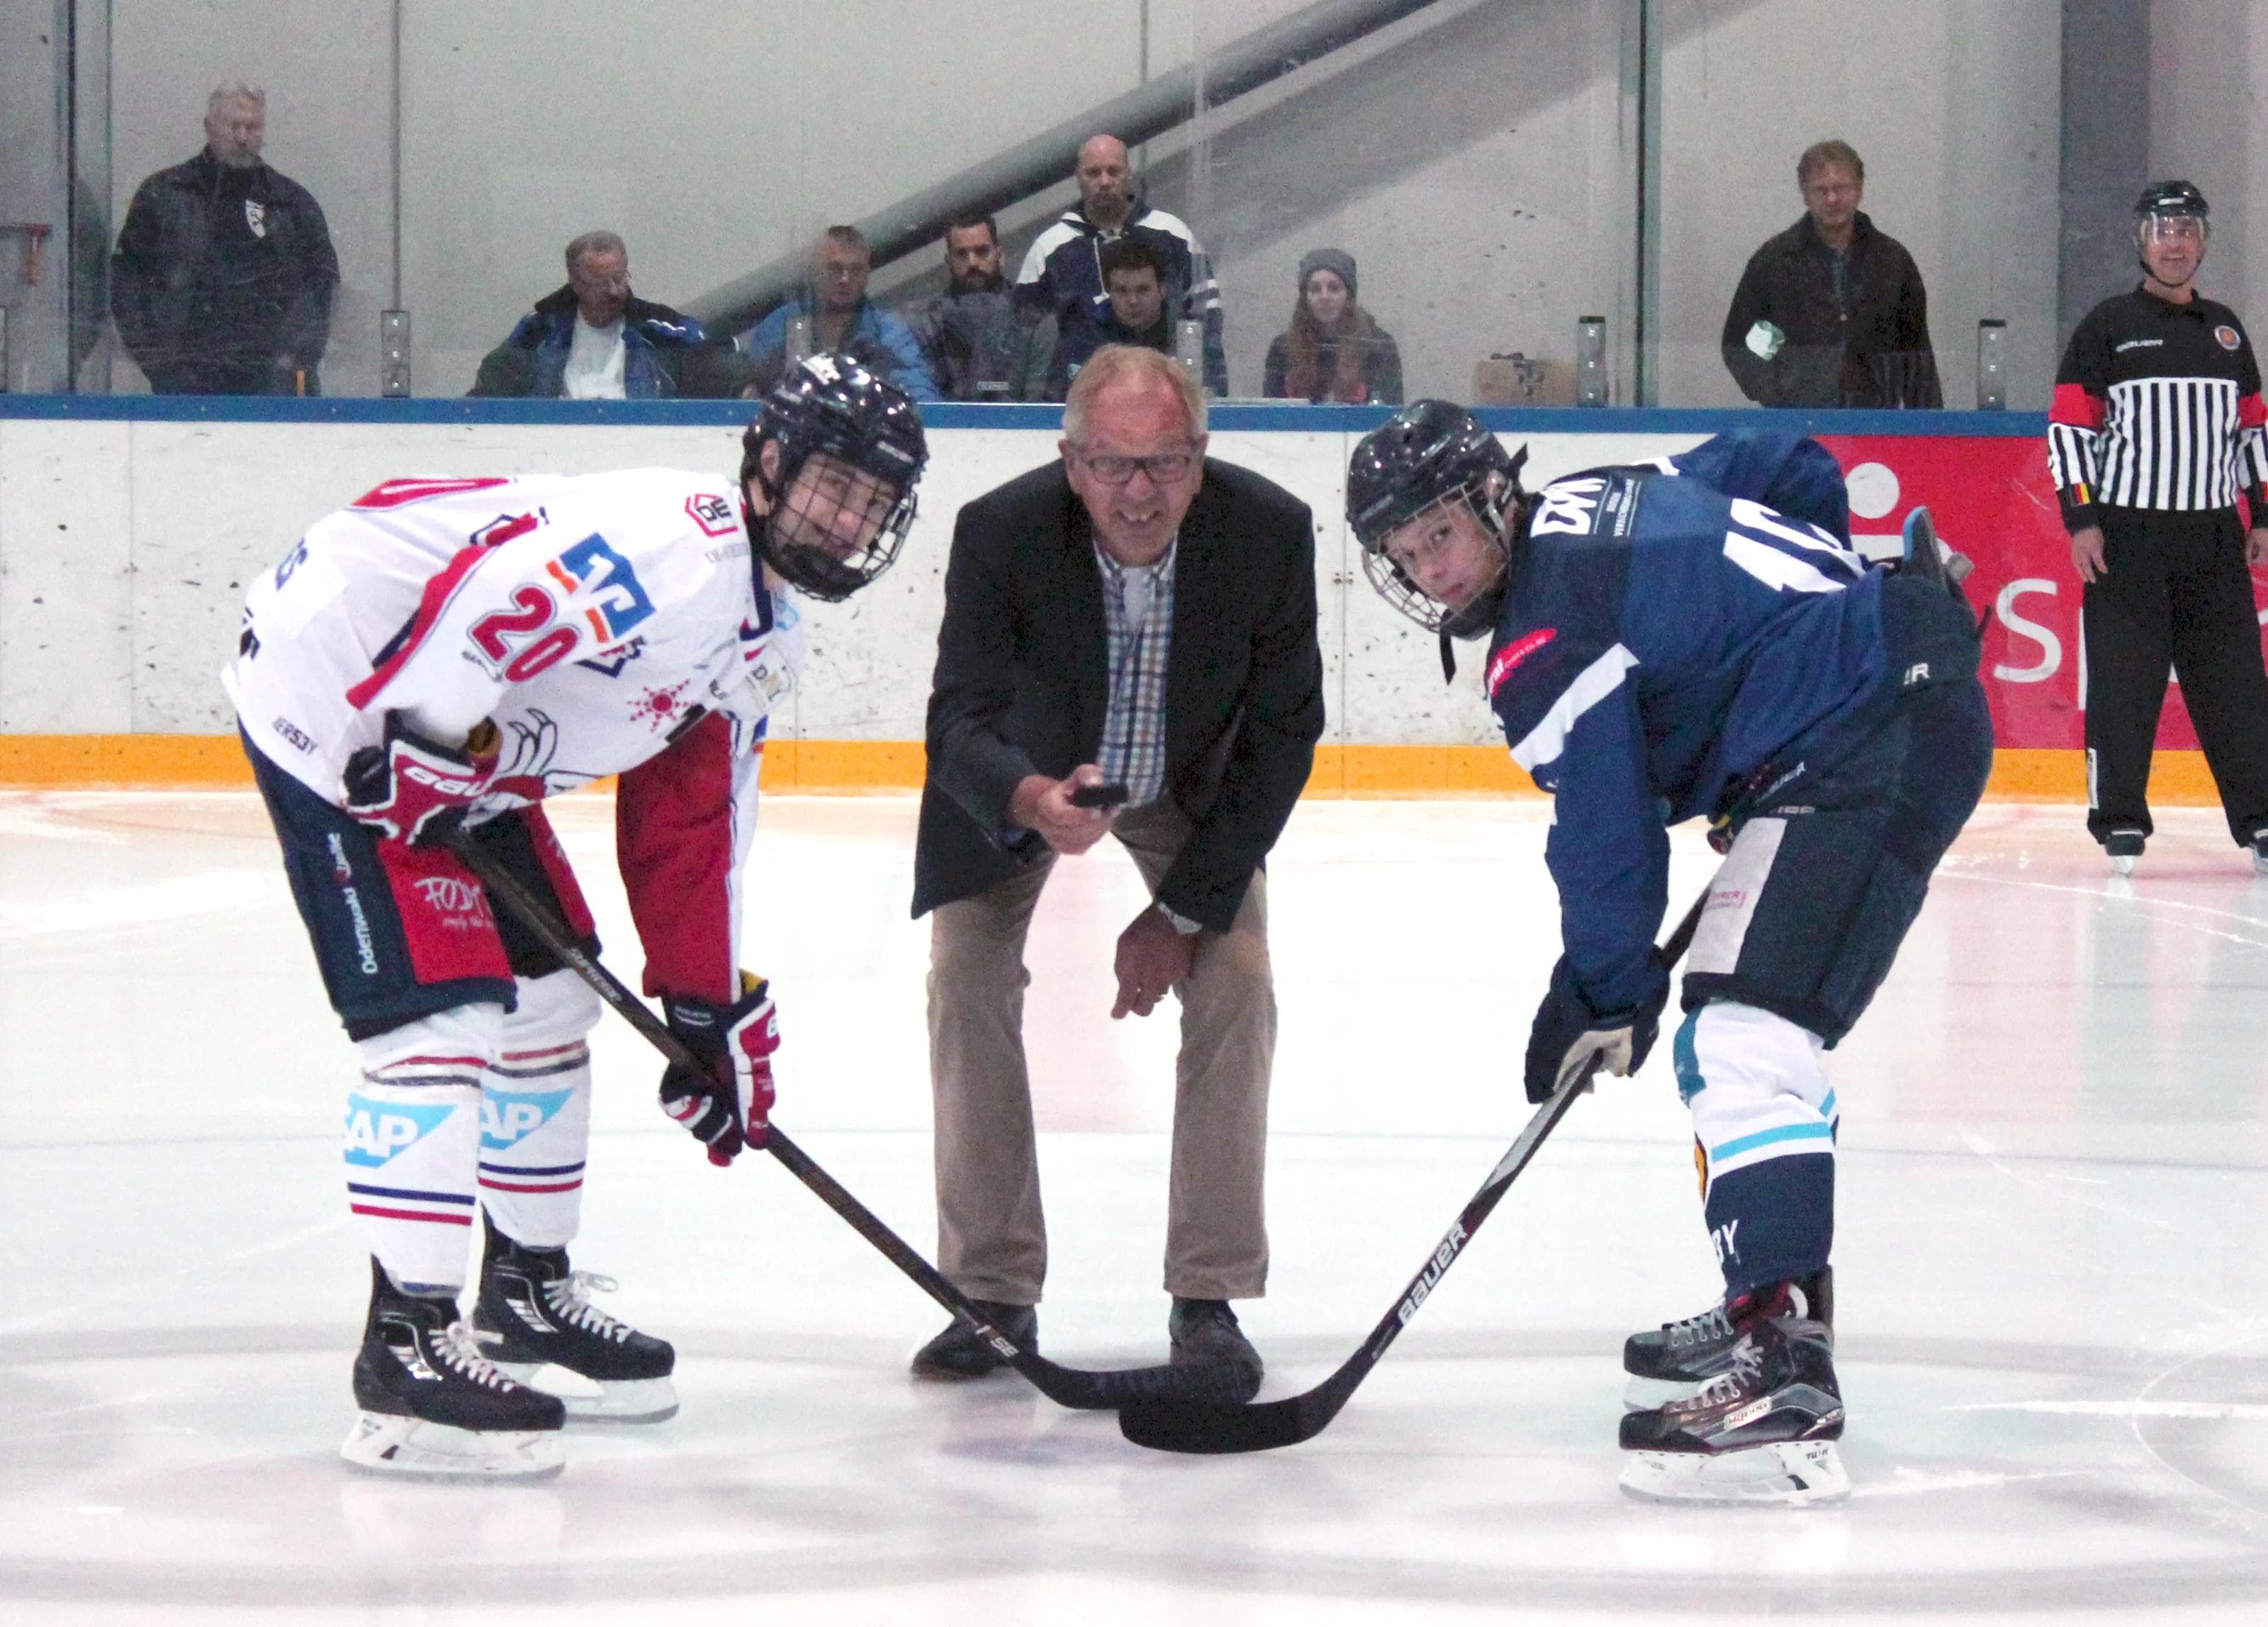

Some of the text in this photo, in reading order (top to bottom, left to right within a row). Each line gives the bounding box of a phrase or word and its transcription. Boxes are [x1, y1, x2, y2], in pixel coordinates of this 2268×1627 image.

[696, 498, 731, 522] DE
[467, 584, 580, 683] 20
[480, 1098, 542, 1140] AP
